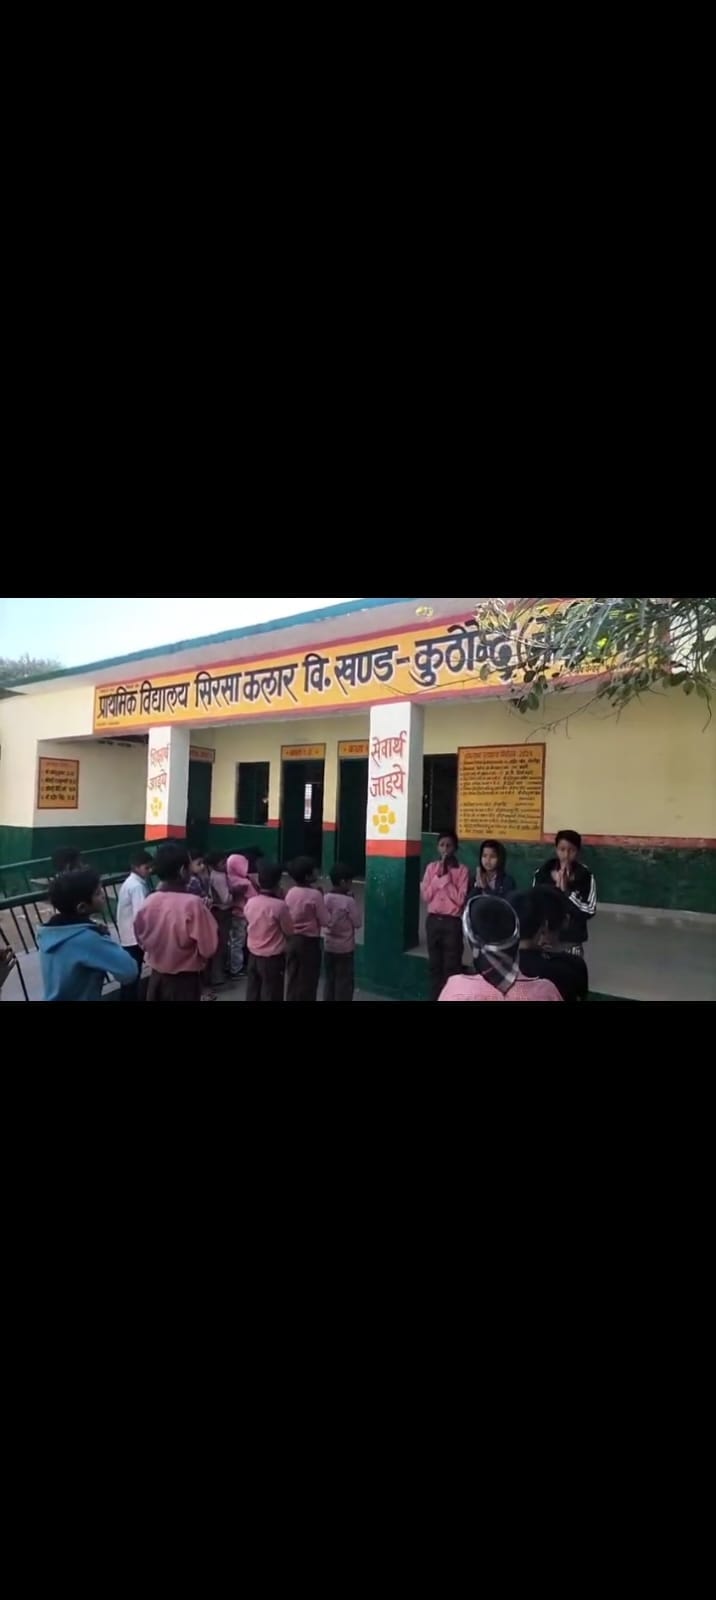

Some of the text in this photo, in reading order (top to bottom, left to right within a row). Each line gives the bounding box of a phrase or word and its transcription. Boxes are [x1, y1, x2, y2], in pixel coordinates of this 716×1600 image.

[97, 686, 138, 719] प्राथमिक
[140, 680, 190, 715] विद्यालय
[194, 671, 242, 711] सिरसा
[243, 663, 298, 704] कलार
[371, 730, 407, 767] सेवार्थ
[369, 764, 405, 799] जाइये
